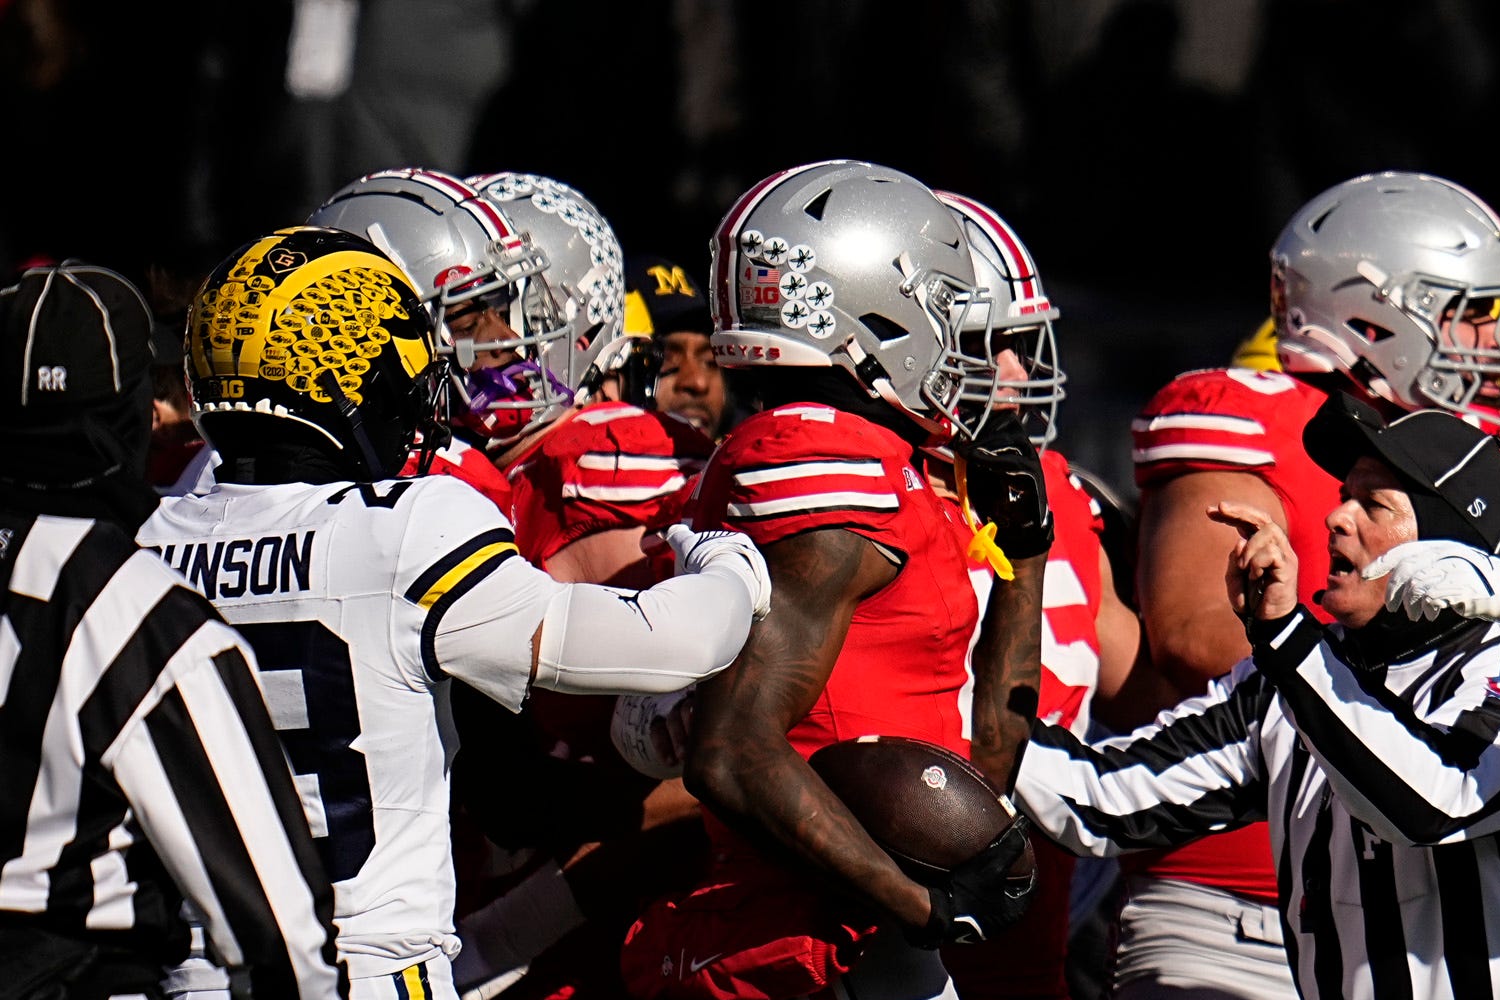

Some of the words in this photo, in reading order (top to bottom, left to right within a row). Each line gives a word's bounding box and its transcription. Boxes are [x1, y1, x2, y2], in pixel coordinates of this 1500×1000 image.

[275, 254, 295, 267] G
[646, 266, 696, 297] M
[235, 327, 255, 336] TED
[37, 365, 67, 391] RR
[263, 366, 286, 377] (202)
[153, 530, 316, 600] HNSON
